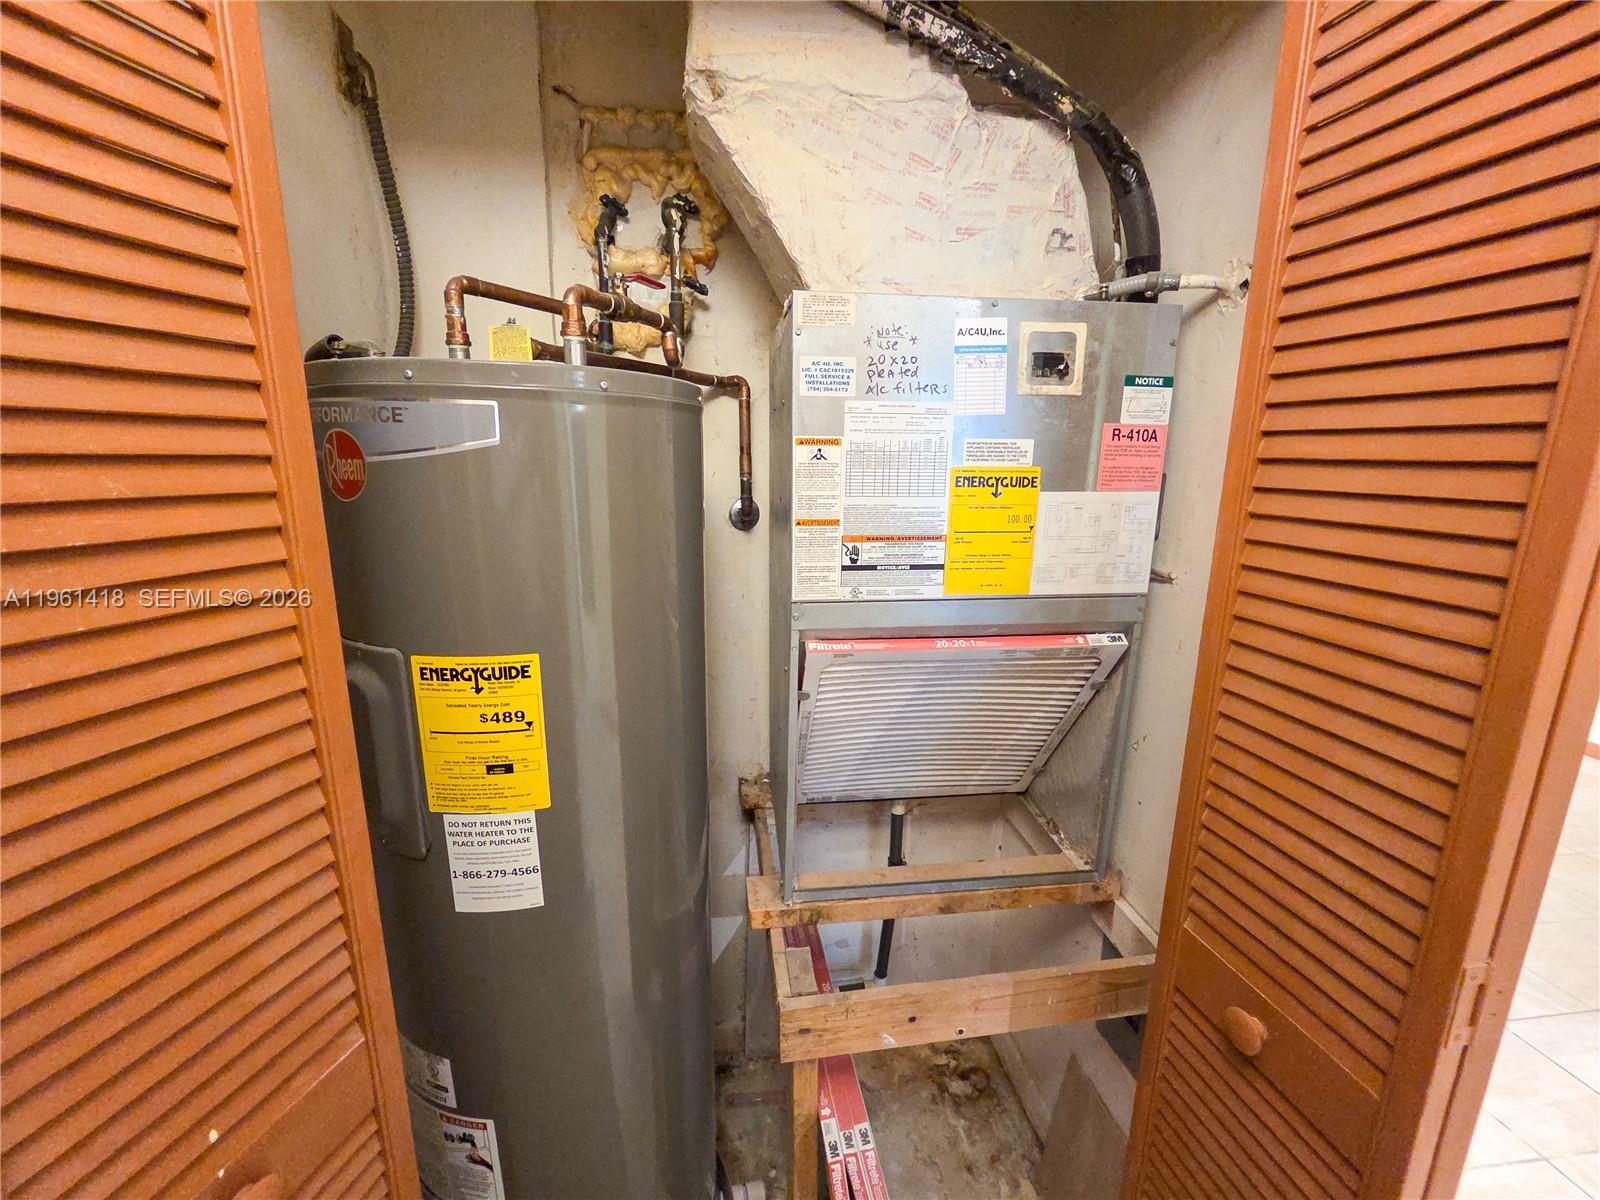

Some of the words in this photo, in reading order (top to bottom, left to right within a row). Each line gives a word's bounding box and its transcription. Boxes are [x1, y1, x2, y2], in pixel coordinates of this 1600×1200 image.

[1135, 377, 1164, 386] NOTICE
[1111, 428, 1158, 443] R-410A
[324, 432, 365, 490] Rheem
[955, 475, 1038, 489] ENERGYGUIDE
[1007, 514, 1033, 524] 100.00
[1107, 635, 1124, 643] 3M
[419, 664, 532, 682] ENERGYGUIDE
[479, 710, 526, 724] $489
[479, 820, 512, 828] RETURN
[513, 817, 532, 826] THIS
[475, 830, 505, 838] HEATER
[506, 828, 517, 836] TO
[519, 826, 535, 835] THE
[489, 836, 531, 847] PURCHASE
[451, 865, 540, 880] 1-866-279-4566
[843, 1131, 855, 1149] 3M
[859, 1127, 871, 1146] 3M
[828, 1140, 840, 1159] 3M
[845, 1156, 861, 1191] Filtrete
[864, 1150, 880, 1185] Filtrete
